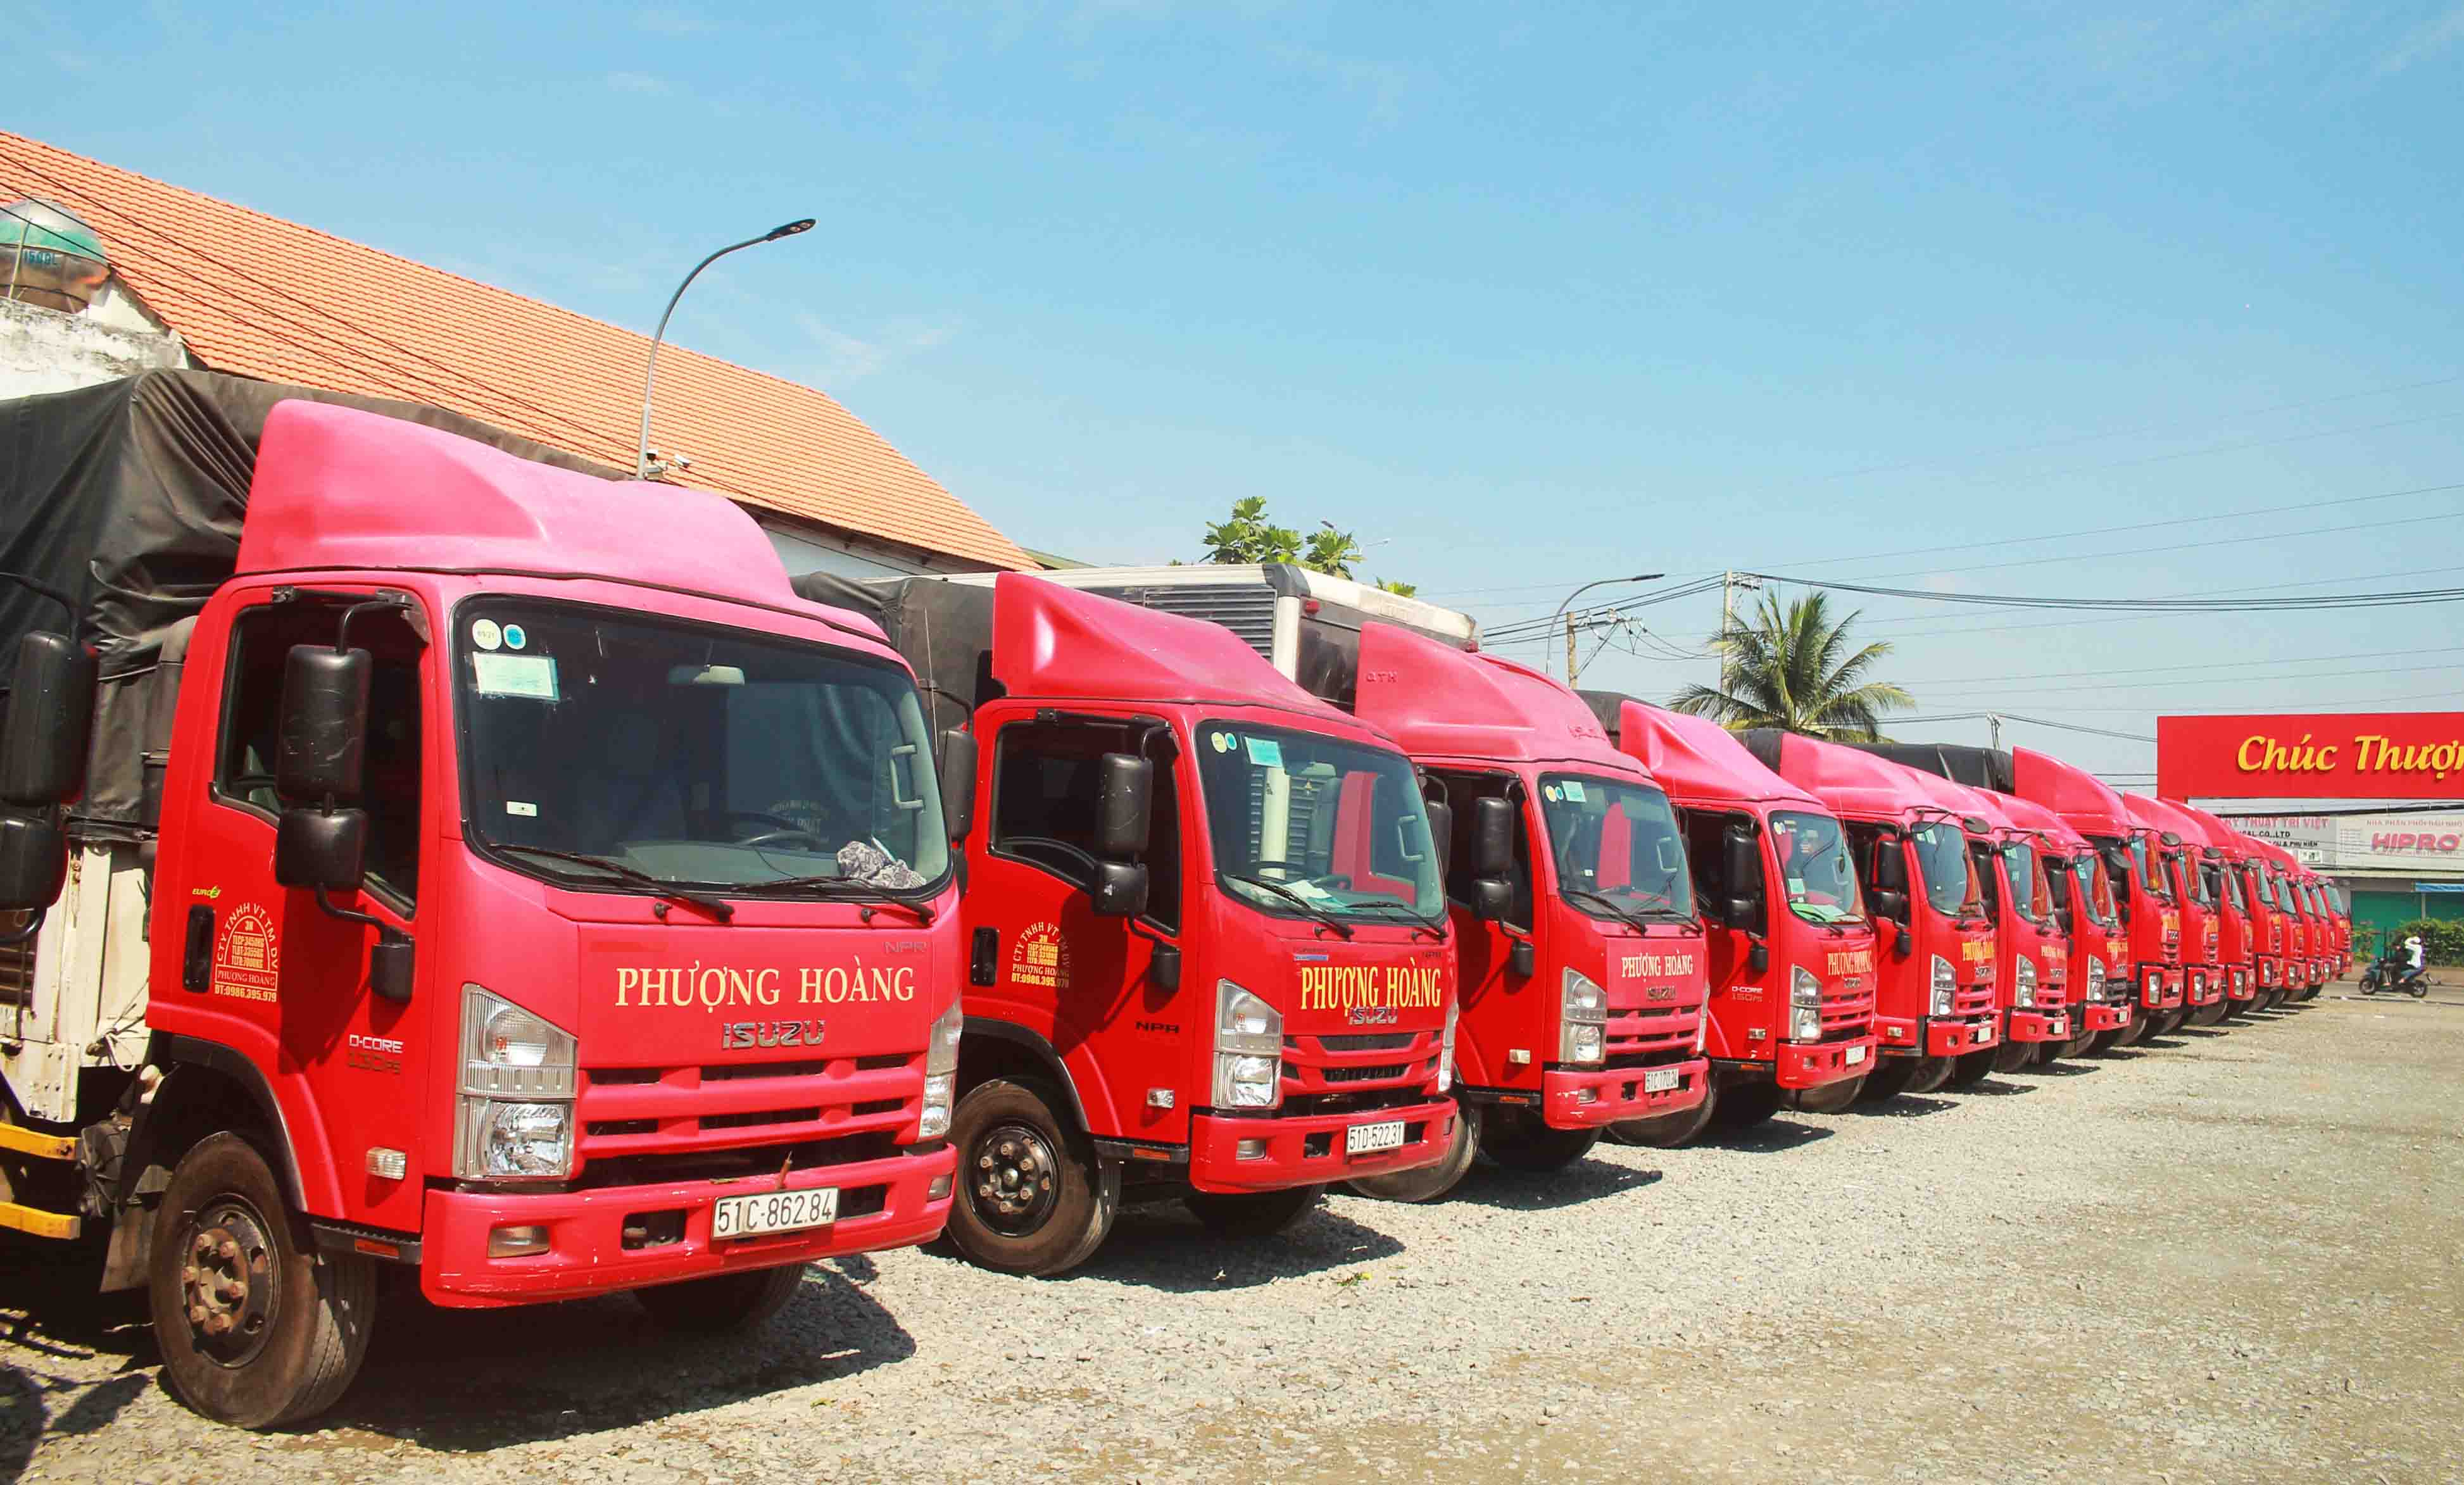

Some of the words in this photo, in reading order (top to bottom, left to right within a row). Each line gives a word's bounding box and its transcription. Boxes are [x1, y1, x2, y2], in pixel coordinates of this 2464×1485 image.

[2237, 734, 2338, 771] Chúc
[2371, 832, 2461, 851] HIPRO
[217, 932, 227, 962] CTY
[225, 902, 250, 930] TNHH
[253, 903, 266, 918] VT
[265, 918, 275, 942] TM
[270, 947, 278, 968] DV
[1013, 941, 1024, 962] CTY
[1021, 922, 1044, 942] TNHH
[1048, 923, 1059, 936] VT
[1621, 951, 1661, 982] PHƯỢNG
[1664, 948, 1694, 976] HOÀNG
[614, 960, 781, 1013] PHƯỢNG
[798, 955, 914, 1003] HOÀNG
[1300, 965, 1378, 1017] PHƯỢNG
[1386, 956, 1442, 1007] HOÀNG
[1136, 1022, 1179, 1033] NPR
[1348, 1006, 1397, 1024] ISUZU
[349, 1034, 404, 1053] D-CORE
[722, 1019, 825, 1049] ISUZU
[1350, 1124, 1401, 1150] 51D-522.31
[718, 1191, 831, 1232] 51C-862.84
